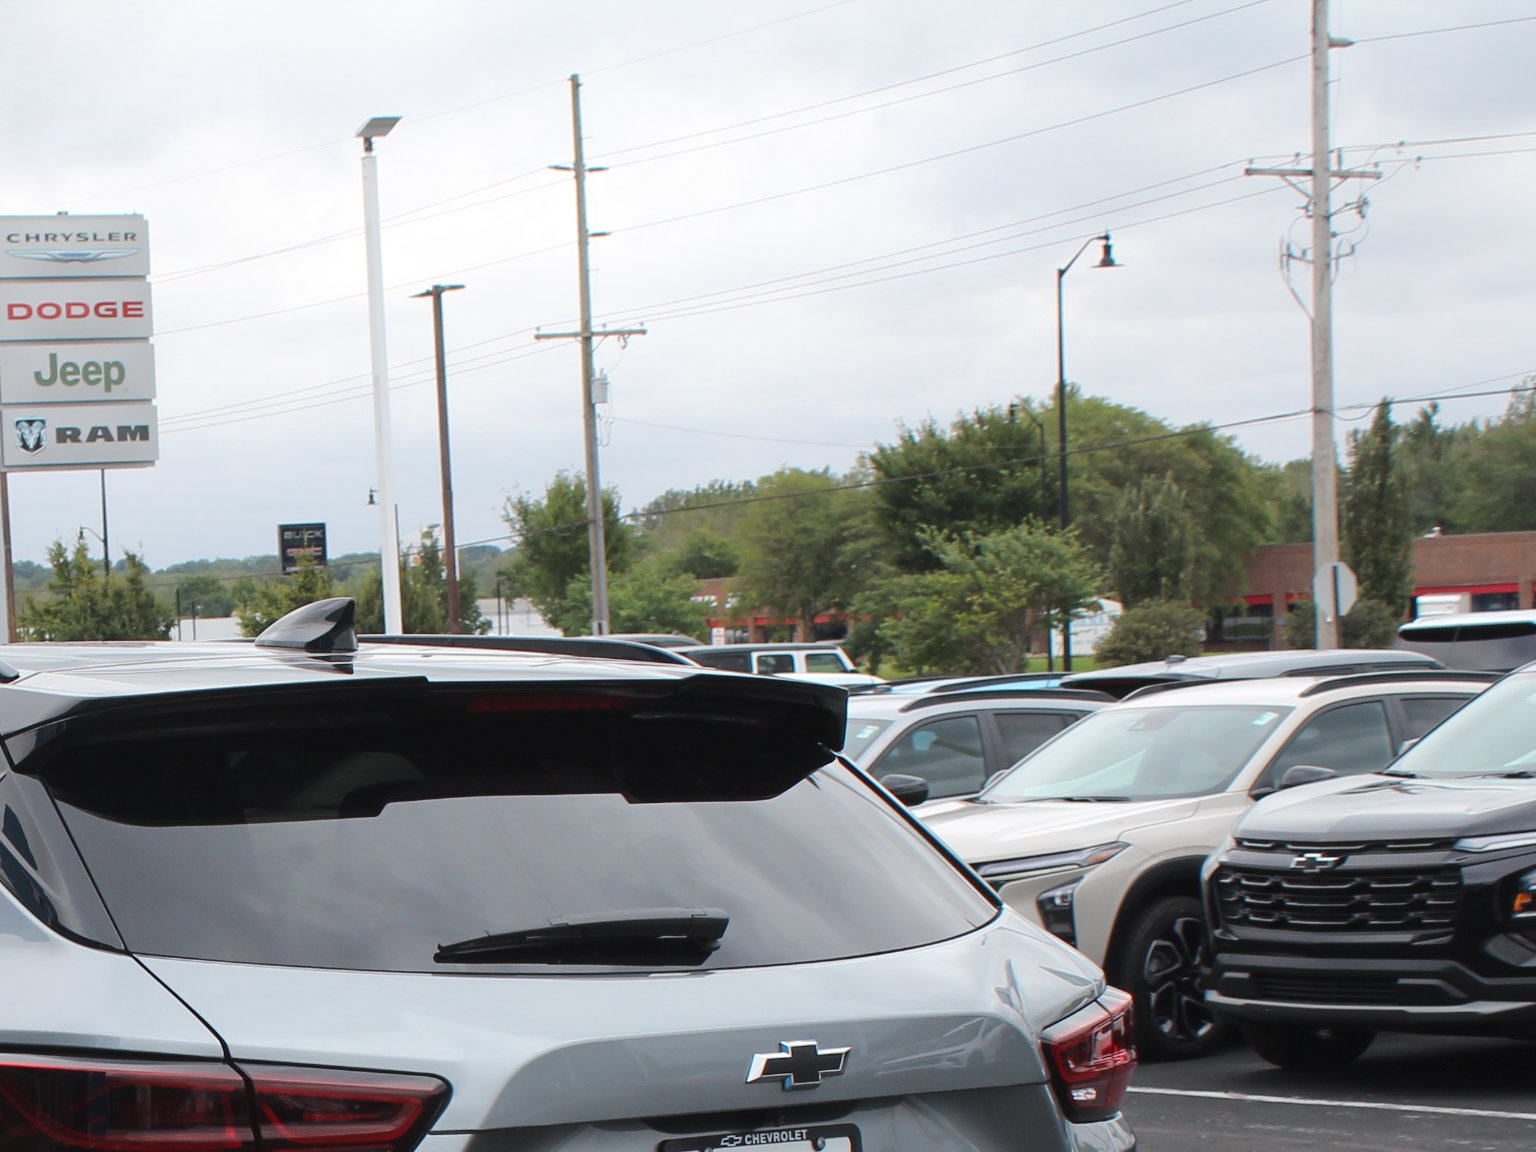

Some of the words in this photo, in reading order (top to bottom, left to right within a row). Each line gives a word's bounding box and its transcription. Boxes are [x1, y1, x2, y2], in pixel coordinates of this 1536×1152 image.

[6, 232, 137, 243] CHRYSLER
[7, 301, 144, 320] DODGE
[34, 353, 126, 392] Jeep
[55, 425, 149, 443] RAM
[745, 1129, 807, 1144] CHEVROLET
